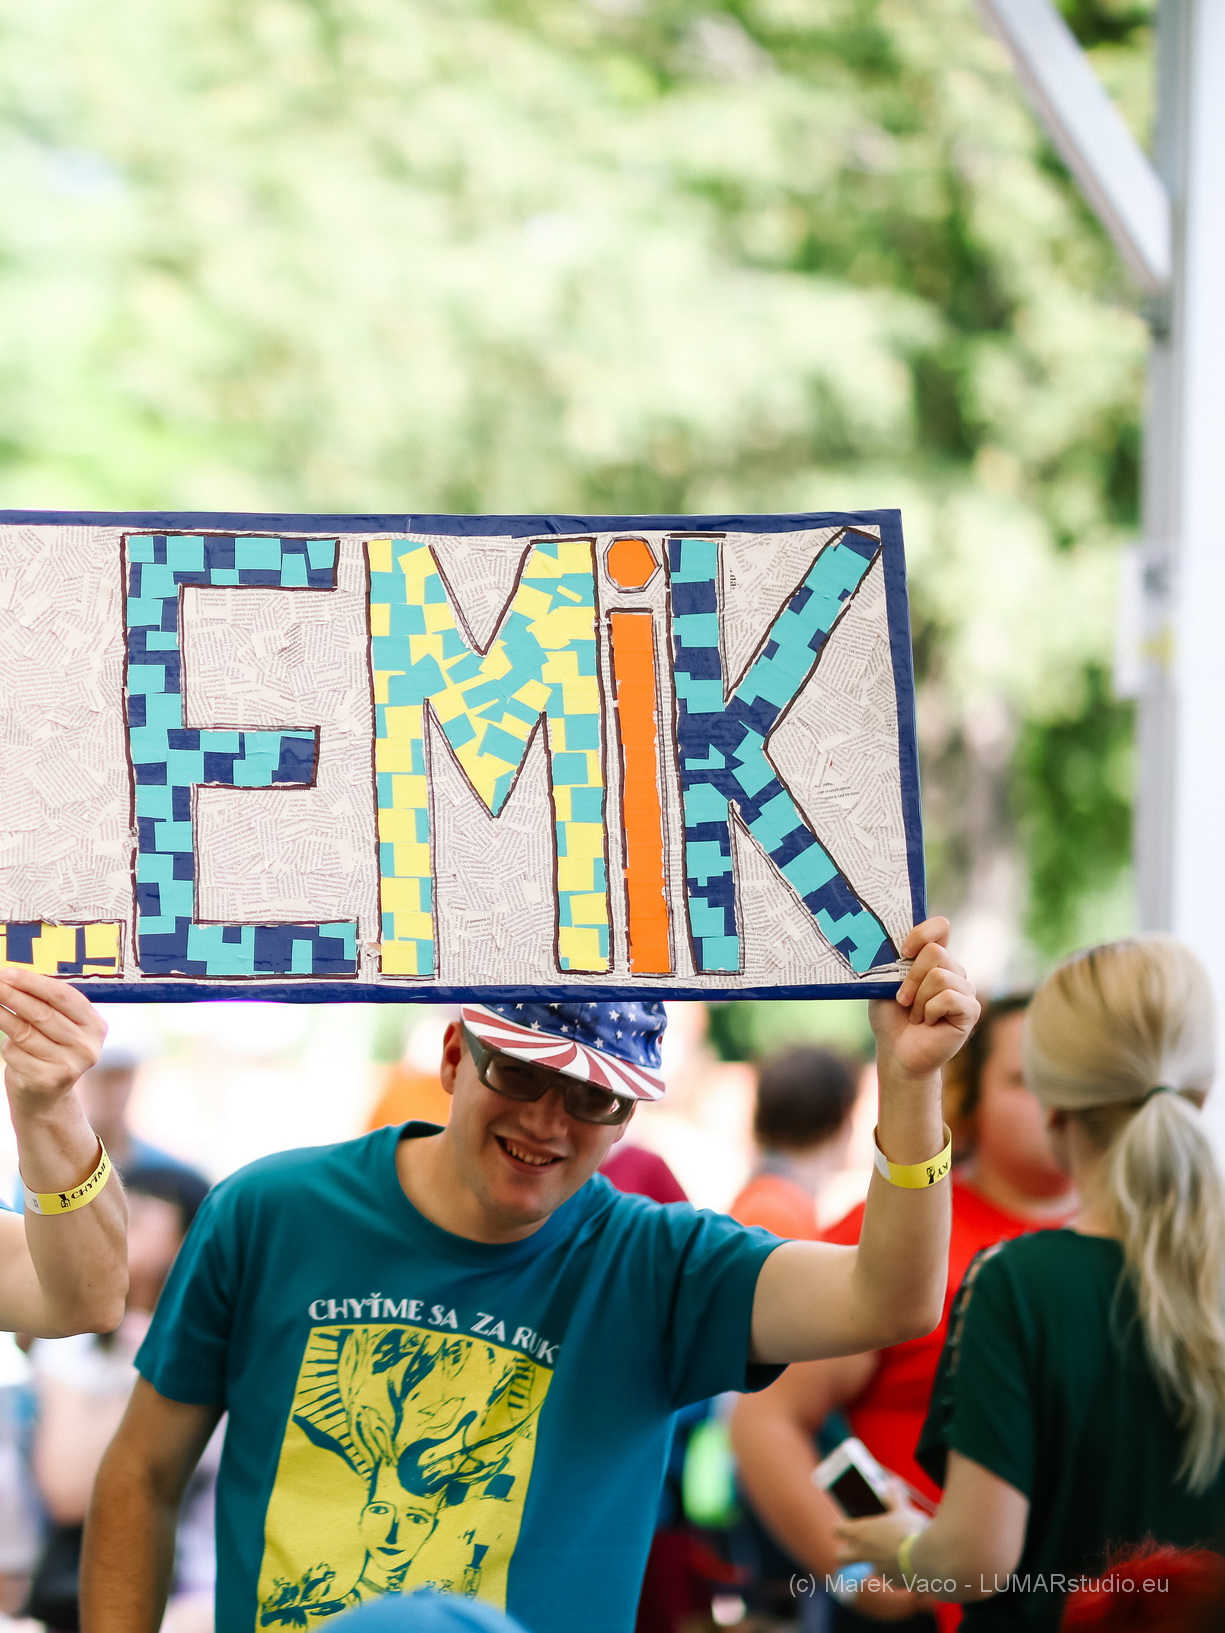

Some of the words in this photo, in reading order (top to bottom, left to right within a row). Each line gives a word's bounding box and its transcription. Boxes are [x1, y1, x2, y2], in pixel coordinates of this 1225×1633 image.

[308, 1292, 425, 1321] CHYŤME
[427, 1304, 459, 1329] SA
[469, 1311, 506, 1342] ZA
